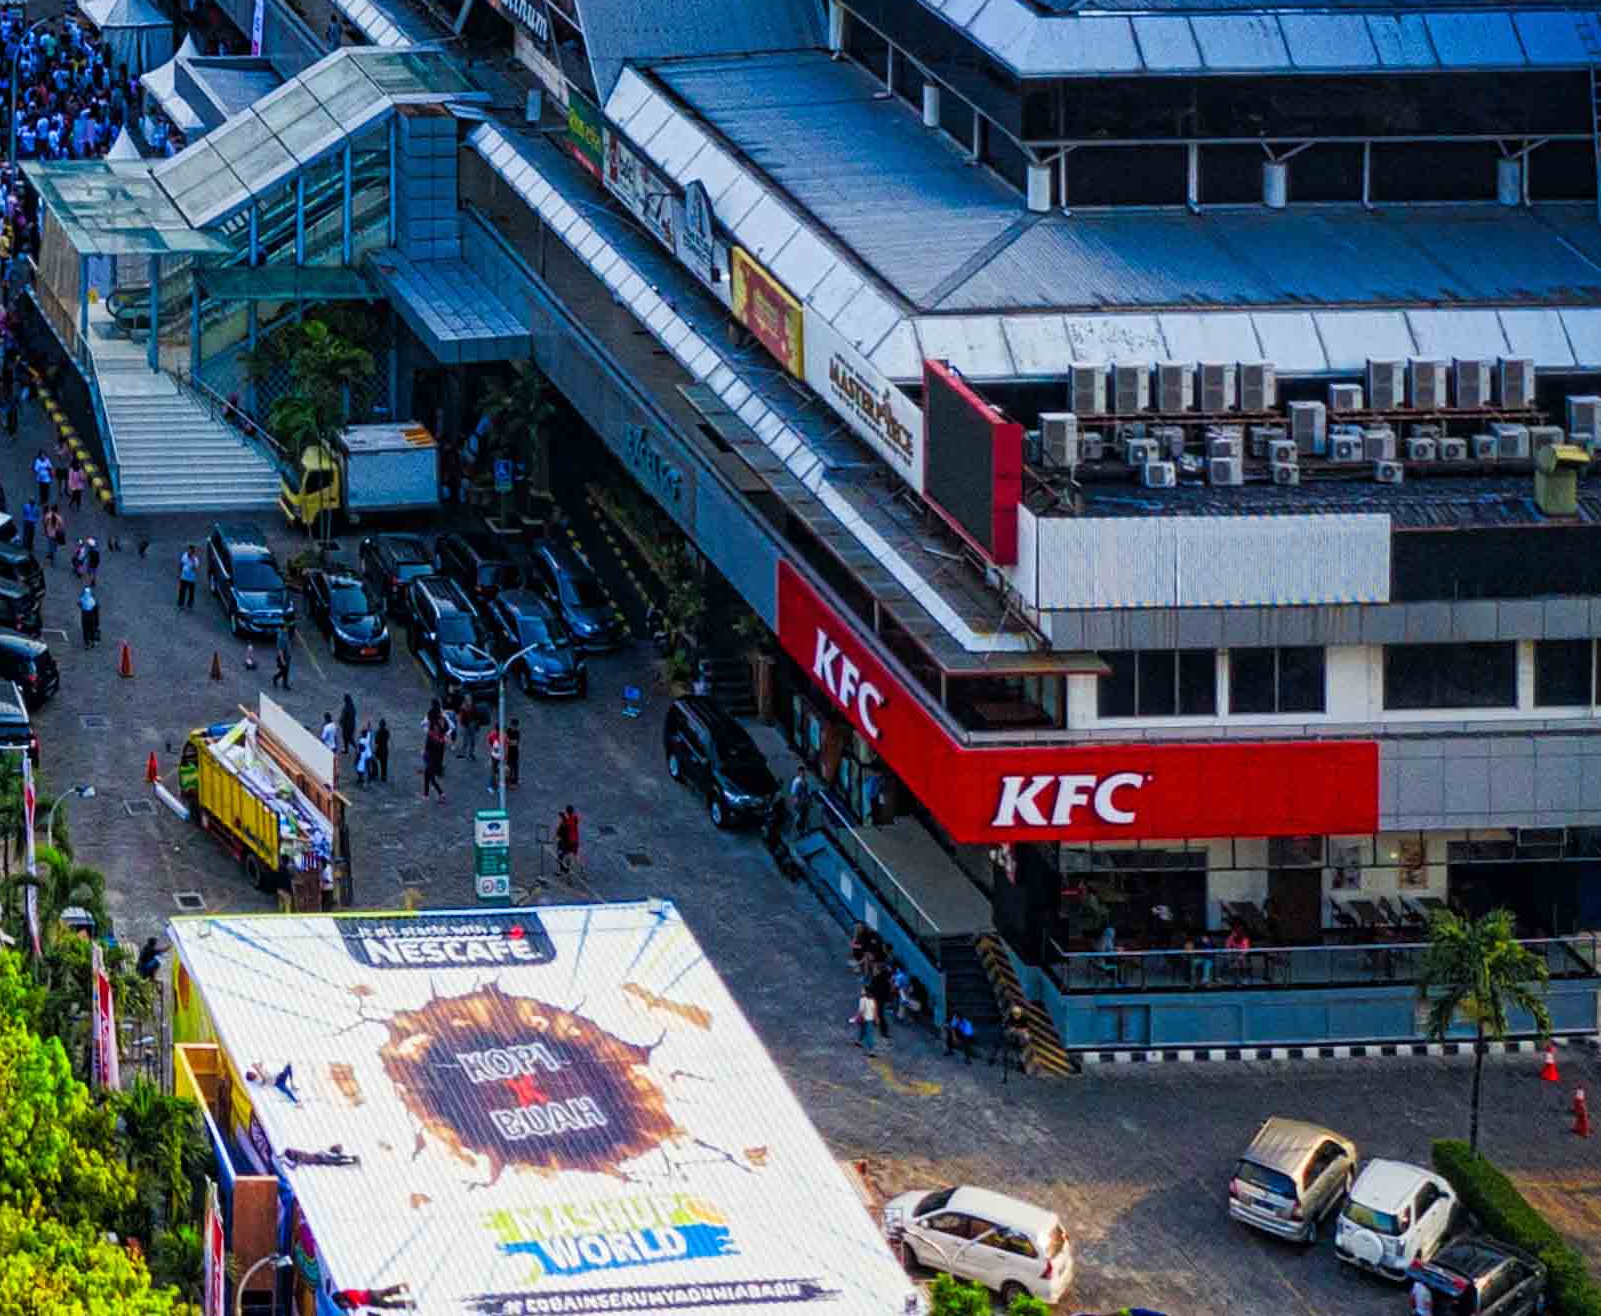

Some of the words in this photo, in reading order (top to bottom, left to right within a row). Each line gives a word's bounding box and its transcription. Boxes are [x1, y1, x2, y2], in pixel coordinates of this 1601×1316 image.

[812, 627, 884, 739] KFC
[991, 772, 1144, 826] KFC
[456, 1043, 560, 1084] KOPI
[489, 1096, 608, 1140] BUAH
[514, 1195, 678, 1241] MASHUP
[536, 1227, 688, 1272] WORLD
